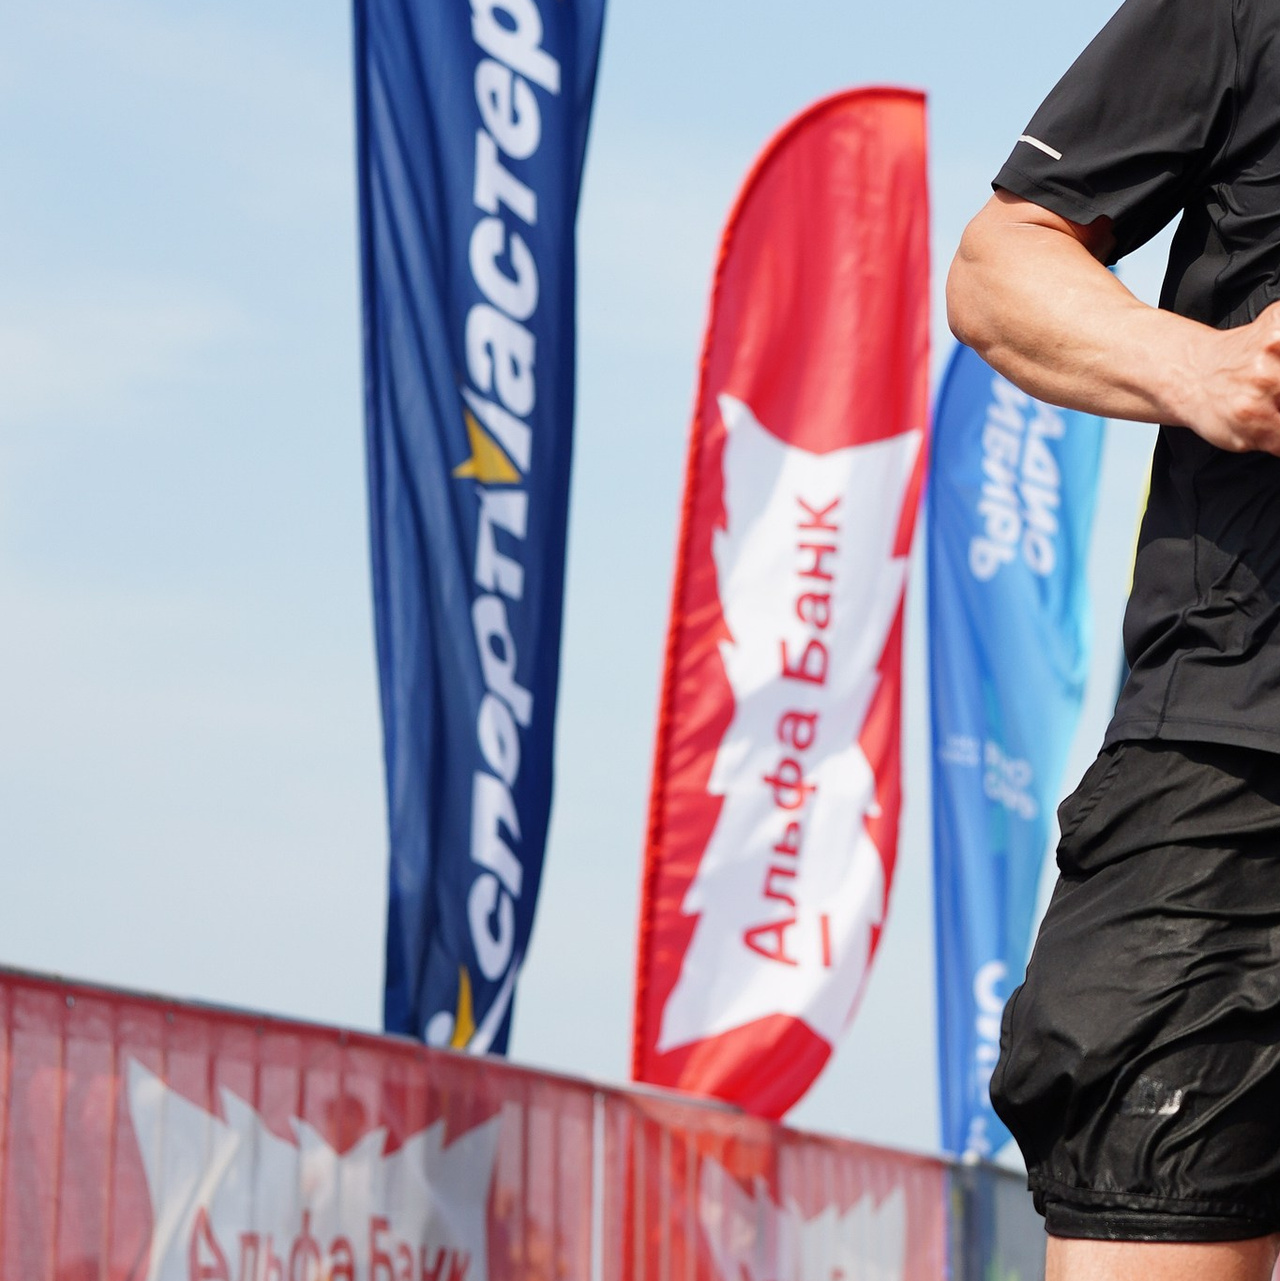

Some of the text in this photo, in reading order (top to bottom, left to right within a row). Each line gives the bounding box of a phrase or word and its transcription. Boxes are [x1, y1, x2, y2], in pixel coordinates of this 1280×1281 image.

[969, 377, 1029, 581] ИБИРЬ
[1022, 400, 1065, 577] АДИО
[742, 496, 842, 966] Альфа Банк
